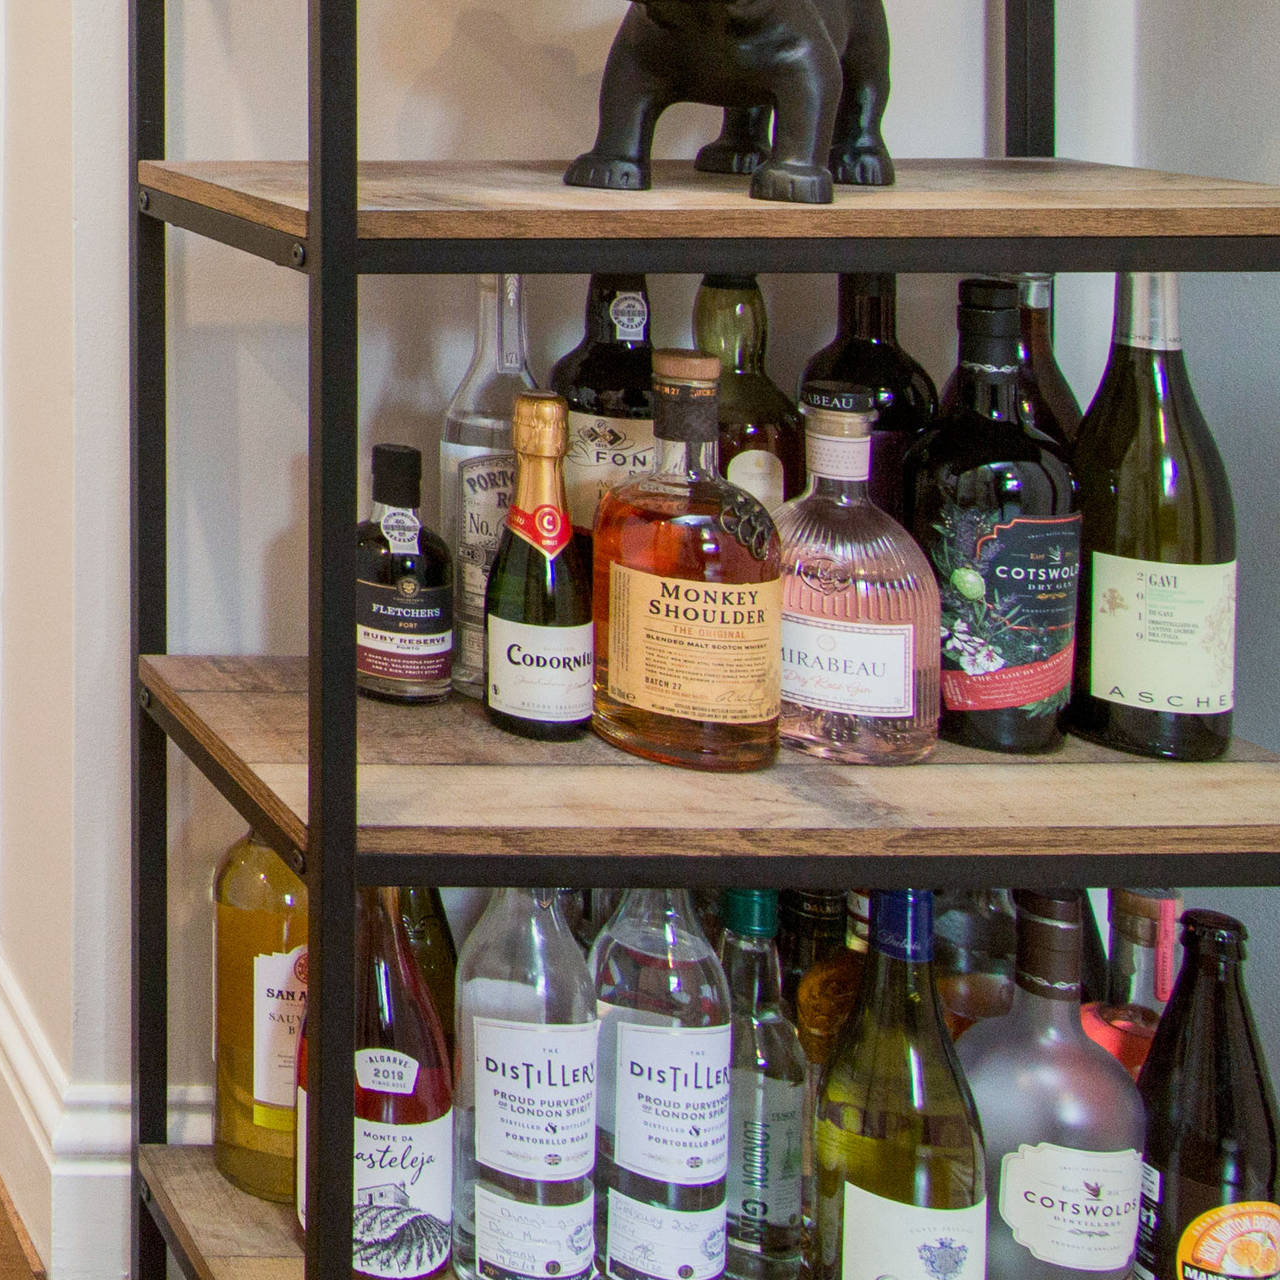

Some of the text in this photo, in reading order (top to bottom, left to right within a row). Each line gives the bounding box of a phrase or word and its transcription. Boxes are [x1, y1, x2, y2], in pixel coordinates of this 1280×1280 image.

[1028, 583, 1052, 591] DRY
[1148, 573, 1178, 589] GAVI
[660, 581, 759, 606] MONKEY
[648, 599, 766, 625] SHOULDER
[363, 630, 446, 645] RUBY RESERVE
[673, 625, 746, 639] THE ORIGINAL
[645, 633, 685, 646] BLENDED
[687, 642, 709, 650] MALT
[645, 676, 682, 690] BATCH 27
[1108, 686, 1235, 708] ASCHE
[266, 988, 295, 1001] SAN
[368, 1056, 408, 1068] ALGARVE
[493, 1089, 536, 1107] PROUD
[637, 1092, 681, 1109] PROUD
[510, 1104, 562, 1118] LONDON
[655, 1108, 706, 1121] LONDON
[363, 1131, 398, 1142] MONTE
[505, 1131, 567, 1145] PORTOBELLO
[648, 1134, 709, 1148] PORTOBELLO
[354, 1145, 435, 1186] asteleja
[1023, 1190, 1137, 1218] COTSWOLDS
